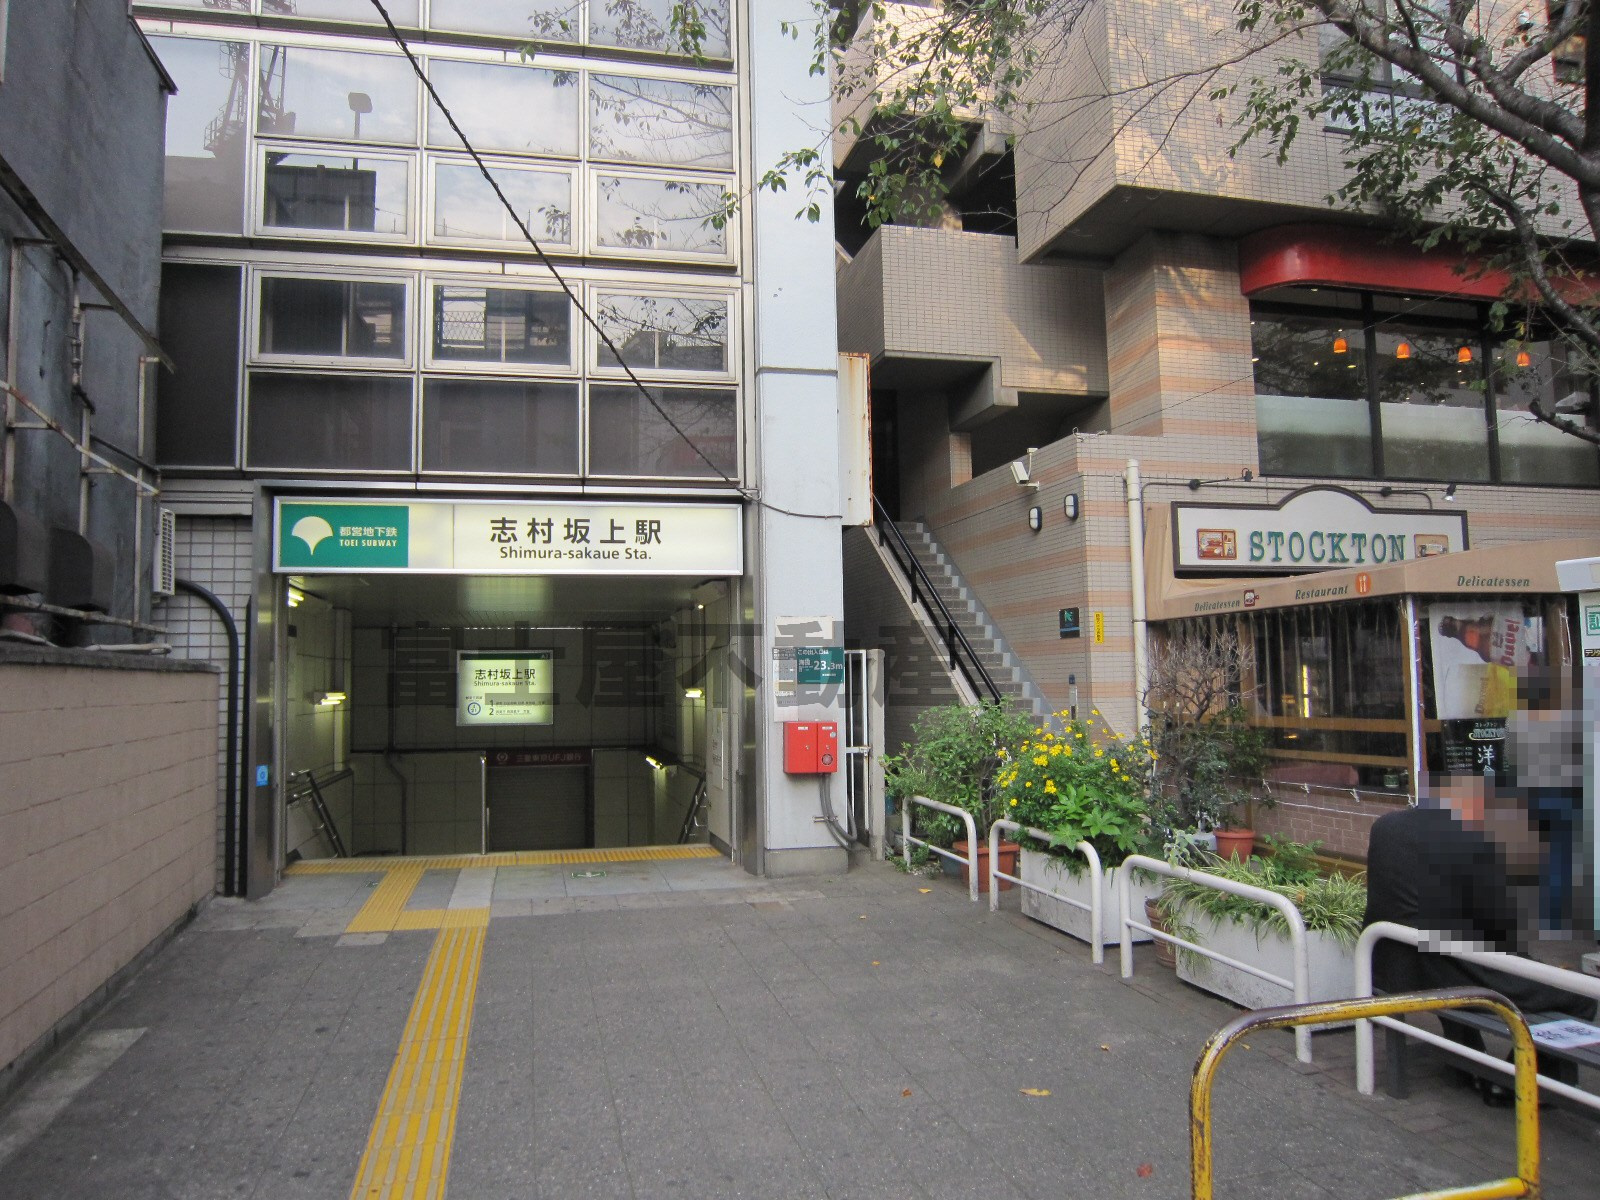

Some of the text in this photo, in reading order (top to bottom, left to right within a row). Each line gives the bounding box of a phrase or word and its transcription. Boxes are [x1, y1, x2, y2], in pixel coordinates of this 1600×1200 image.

[340, 526, 398, 537] 都営地下鉄
[489, 516, 662, 545] 志村坂上駅
[339, 539, 398, 547] TOEI SUBWAY
[1249, 530, 1406, 563] STOCKTON
[499, 546, 653, 560] Shimura-sakaue Sta.
[1457, 575, 1531, 587] Delicatessen
[1294, 585, 1349, 600] Restaurant
[1194, 599, 1241, 612] Delicatessen
[813, 660, 843, 671] 23.3m
[474, 668, 536, 680] 志村坂上駅
[489, 699, 494, 707] 1
[488, 707, 494, 716] 2
